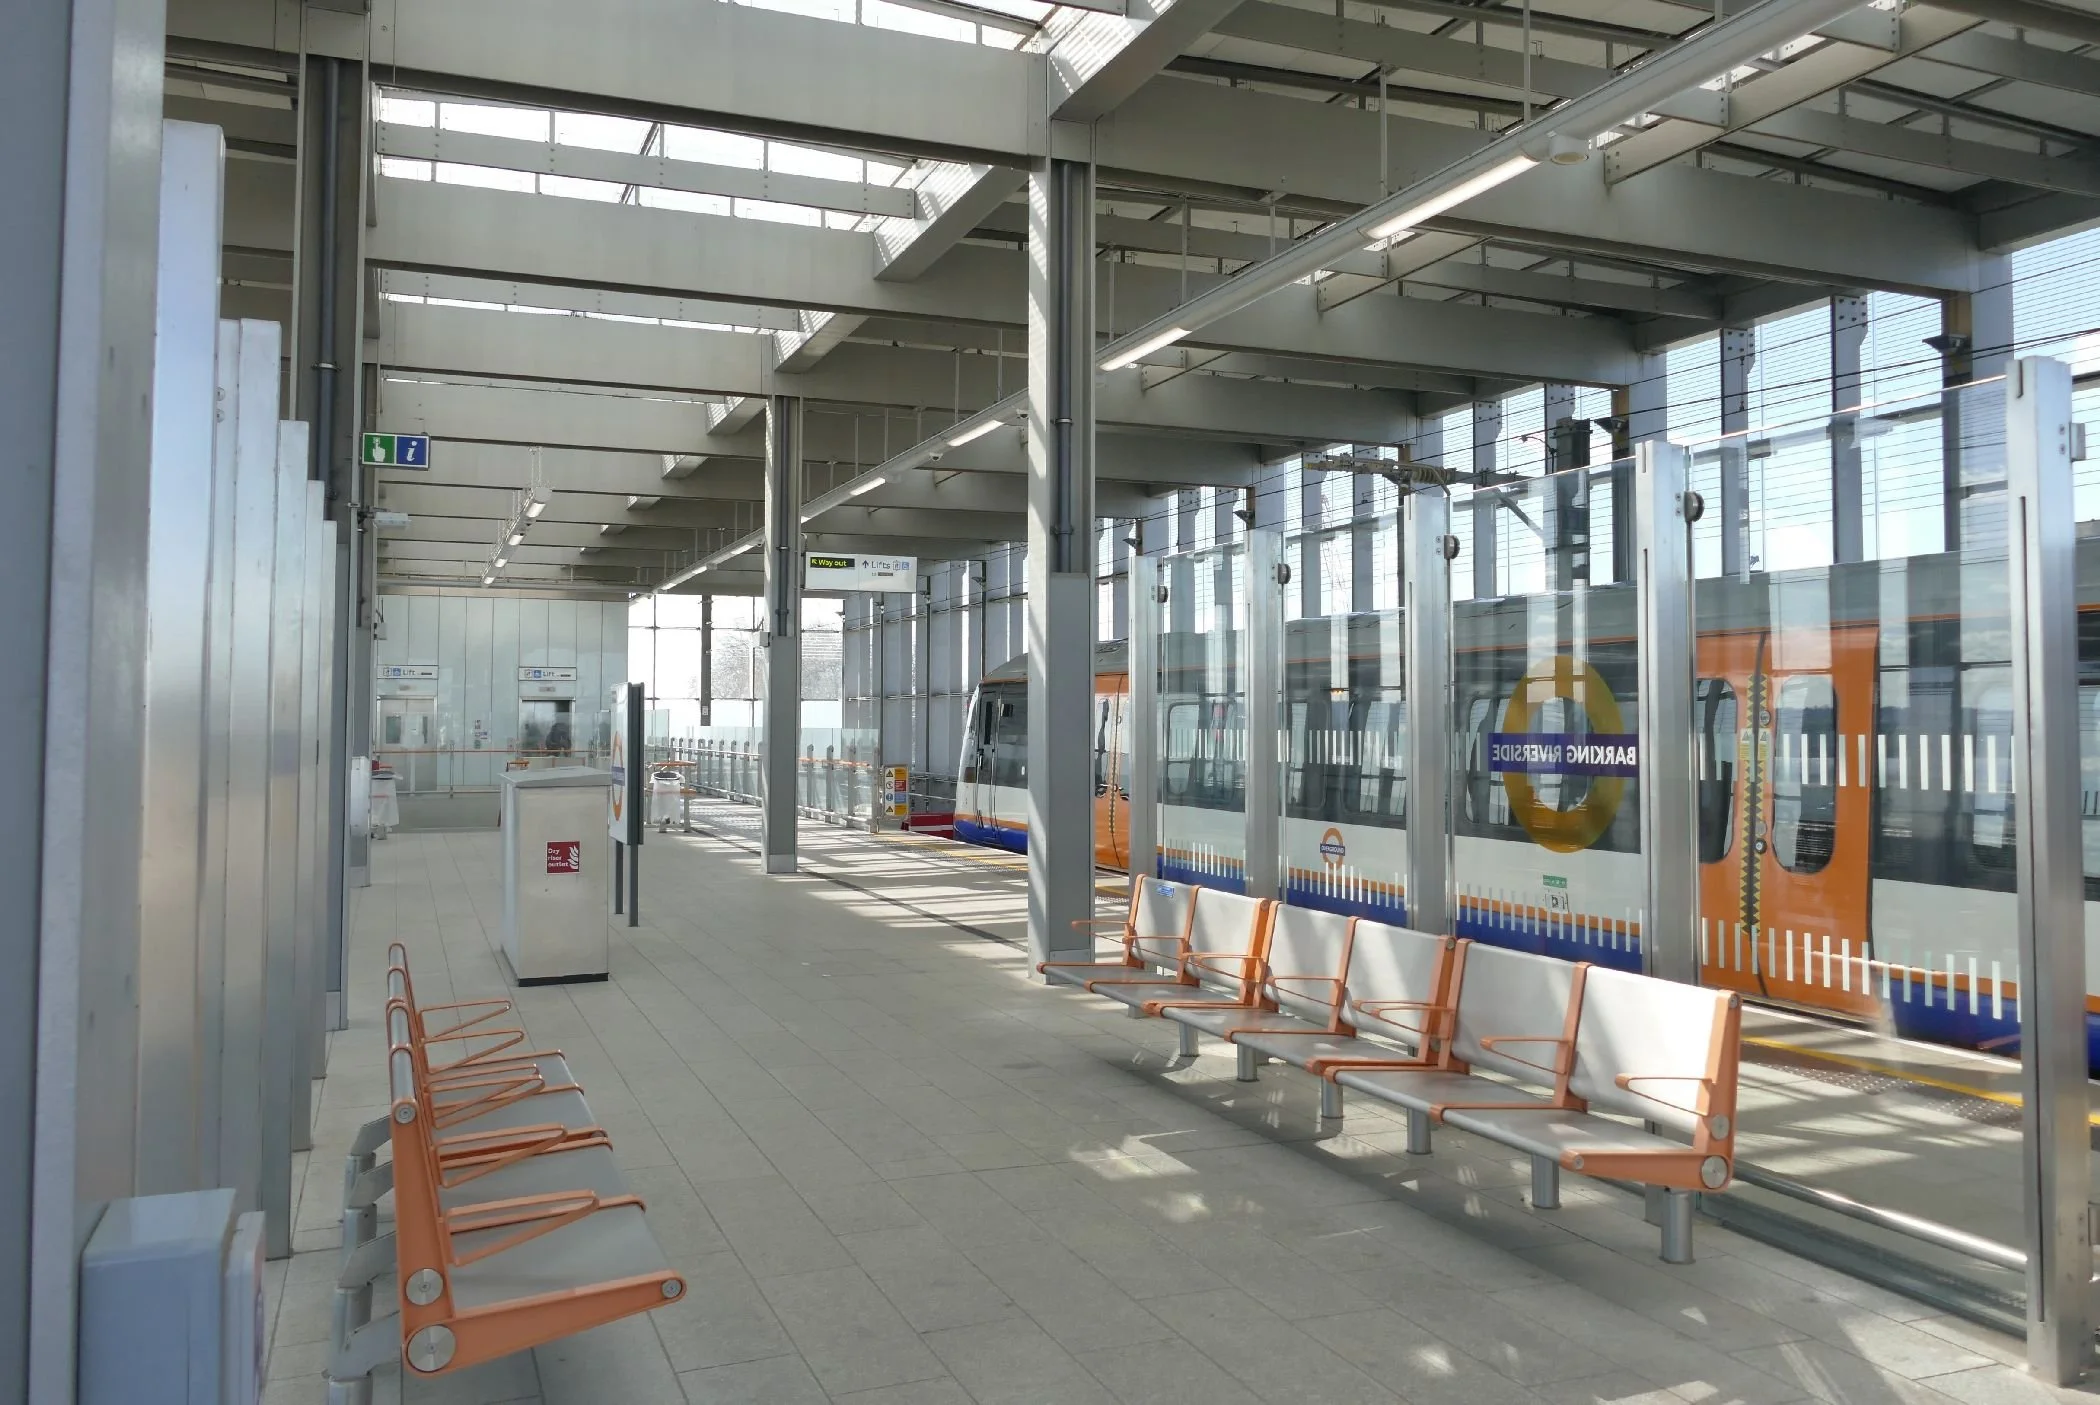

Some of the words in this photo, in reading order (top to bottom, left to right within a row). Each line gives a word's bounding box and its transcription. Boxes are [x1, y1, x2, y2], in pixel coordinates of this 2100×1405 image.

[871, 561, 891, 569] Lifts
[402, 668, 416, 676] Lift
[1321, 845, 1345, 854] OVERGROUND
